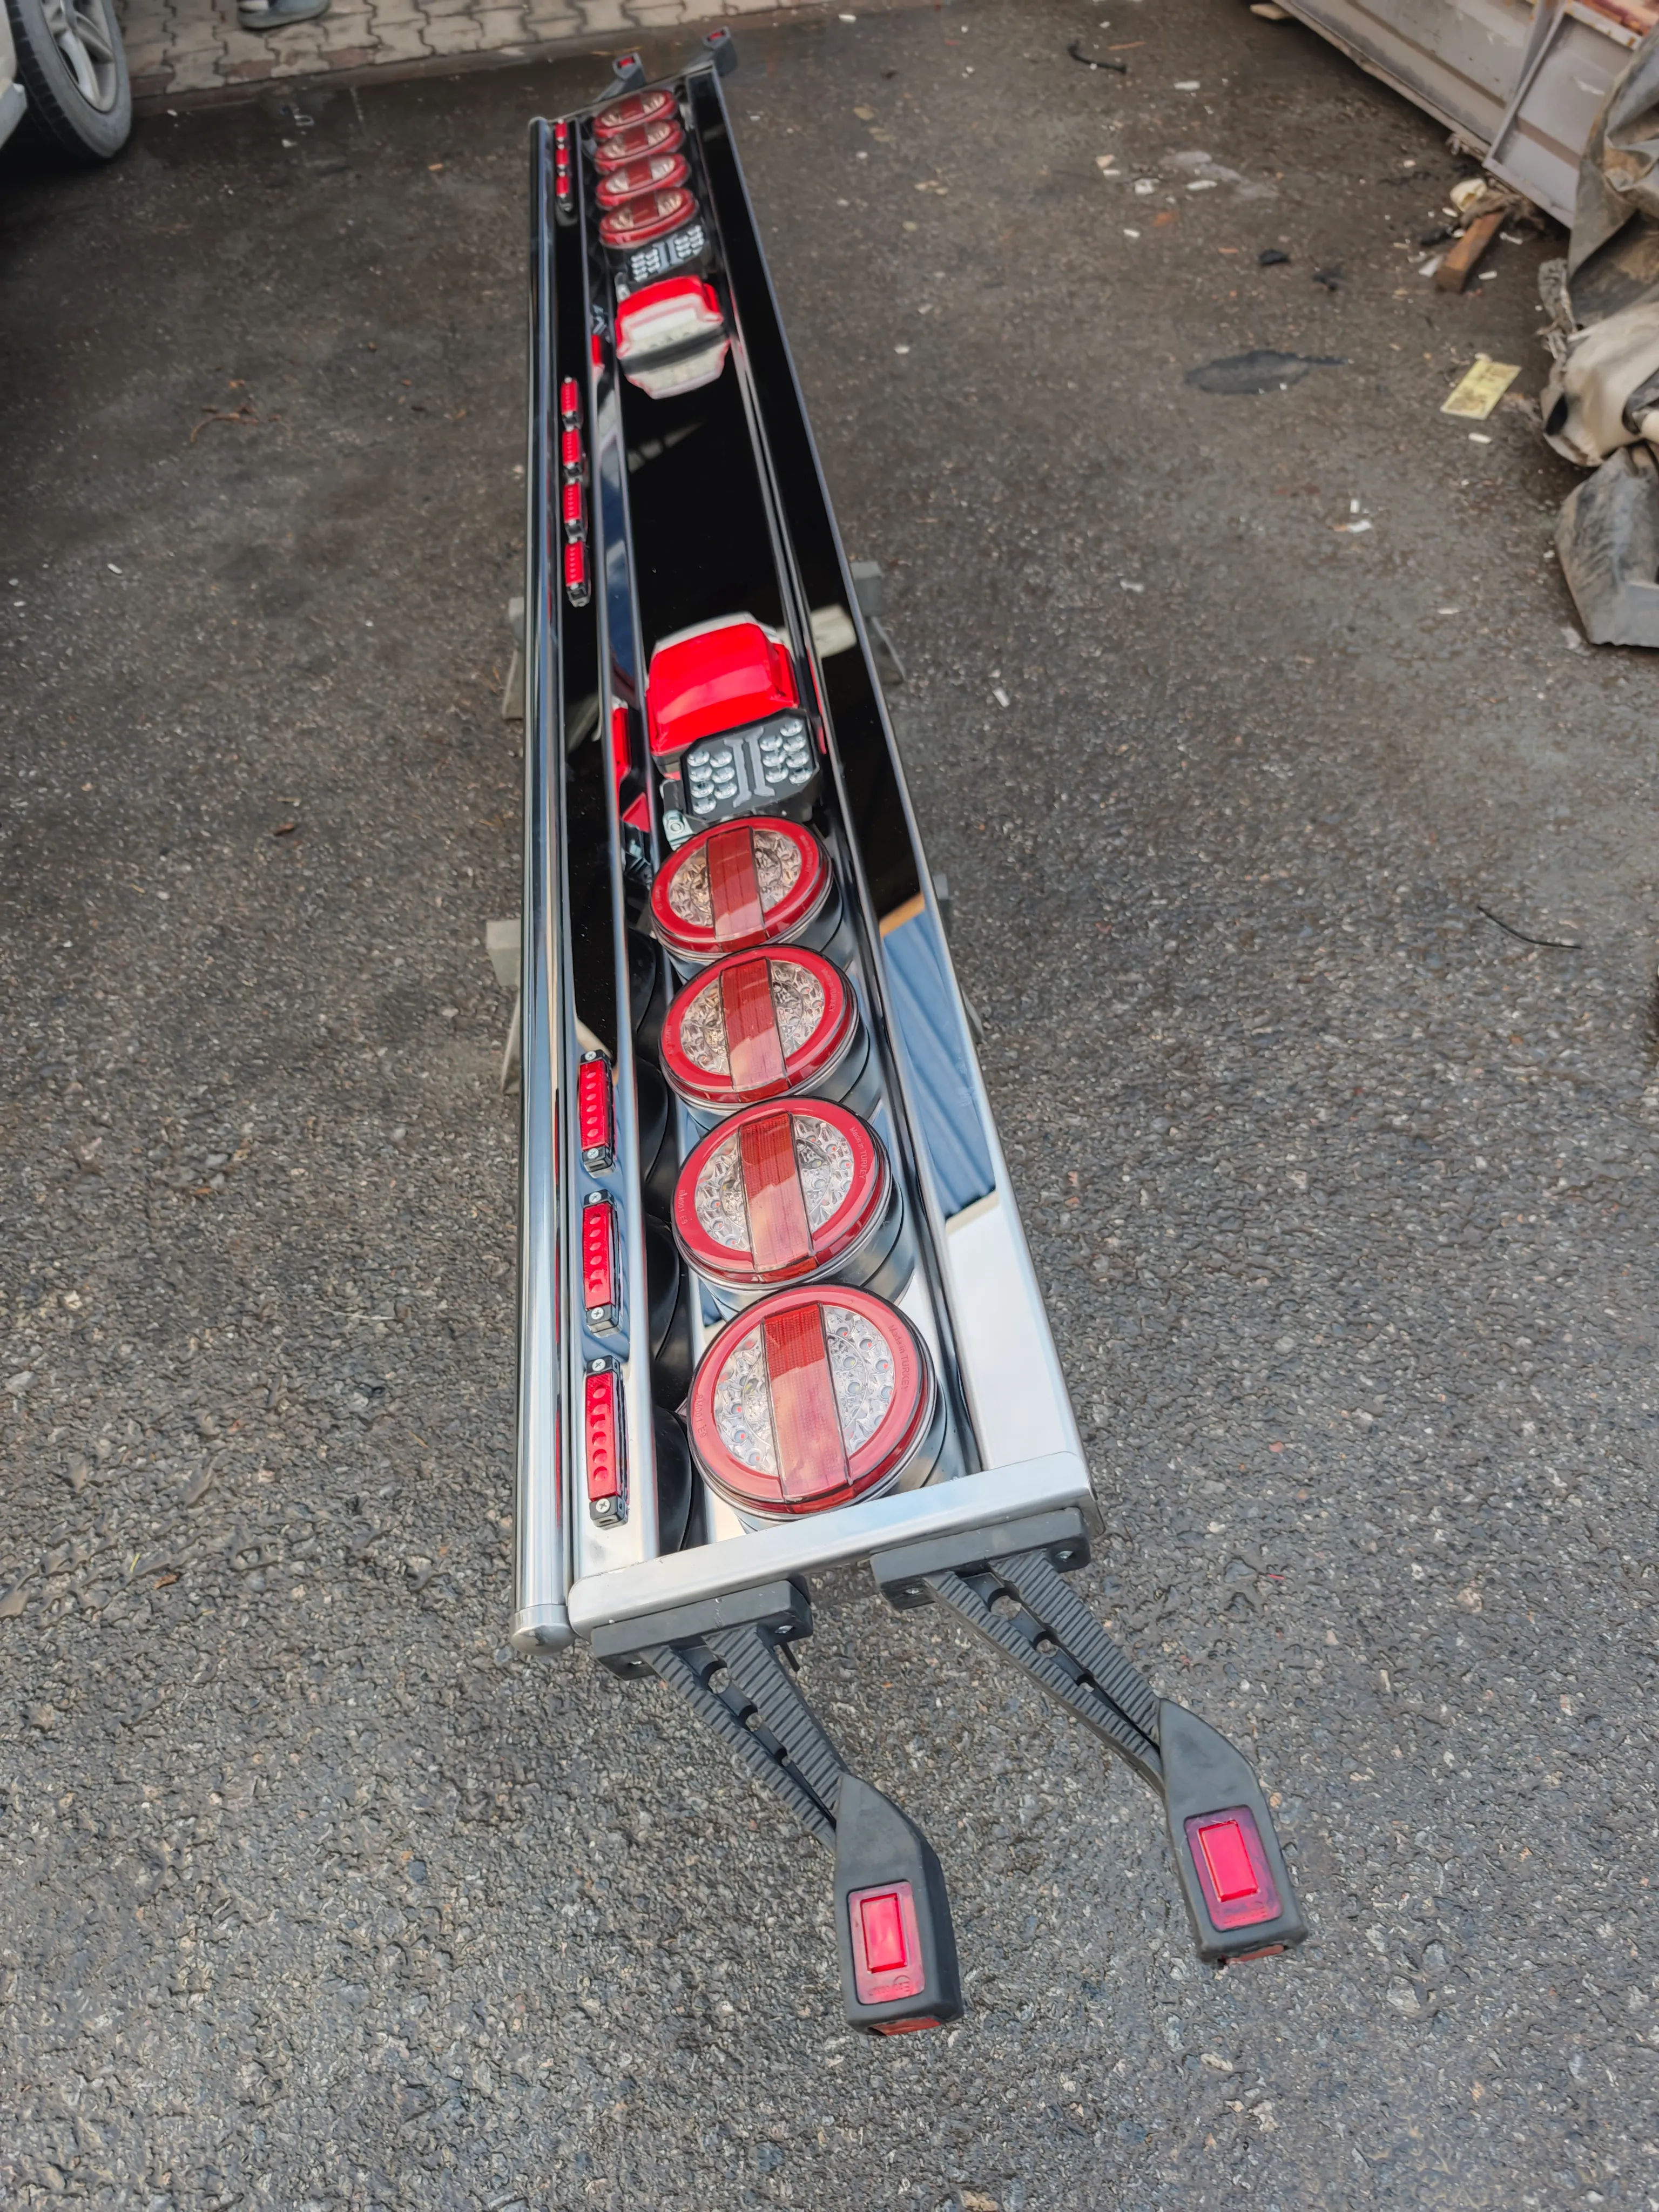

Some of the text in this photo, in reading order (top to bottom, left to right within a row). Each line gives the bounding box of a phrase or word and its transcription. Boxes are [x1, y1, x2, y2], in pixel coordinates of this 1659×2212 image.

[849, 1126, 862, 1143] Made
[859, 1150, 868, 1179] TURKEY
[888, 1324, 910, 1392] Made in TURKEY
